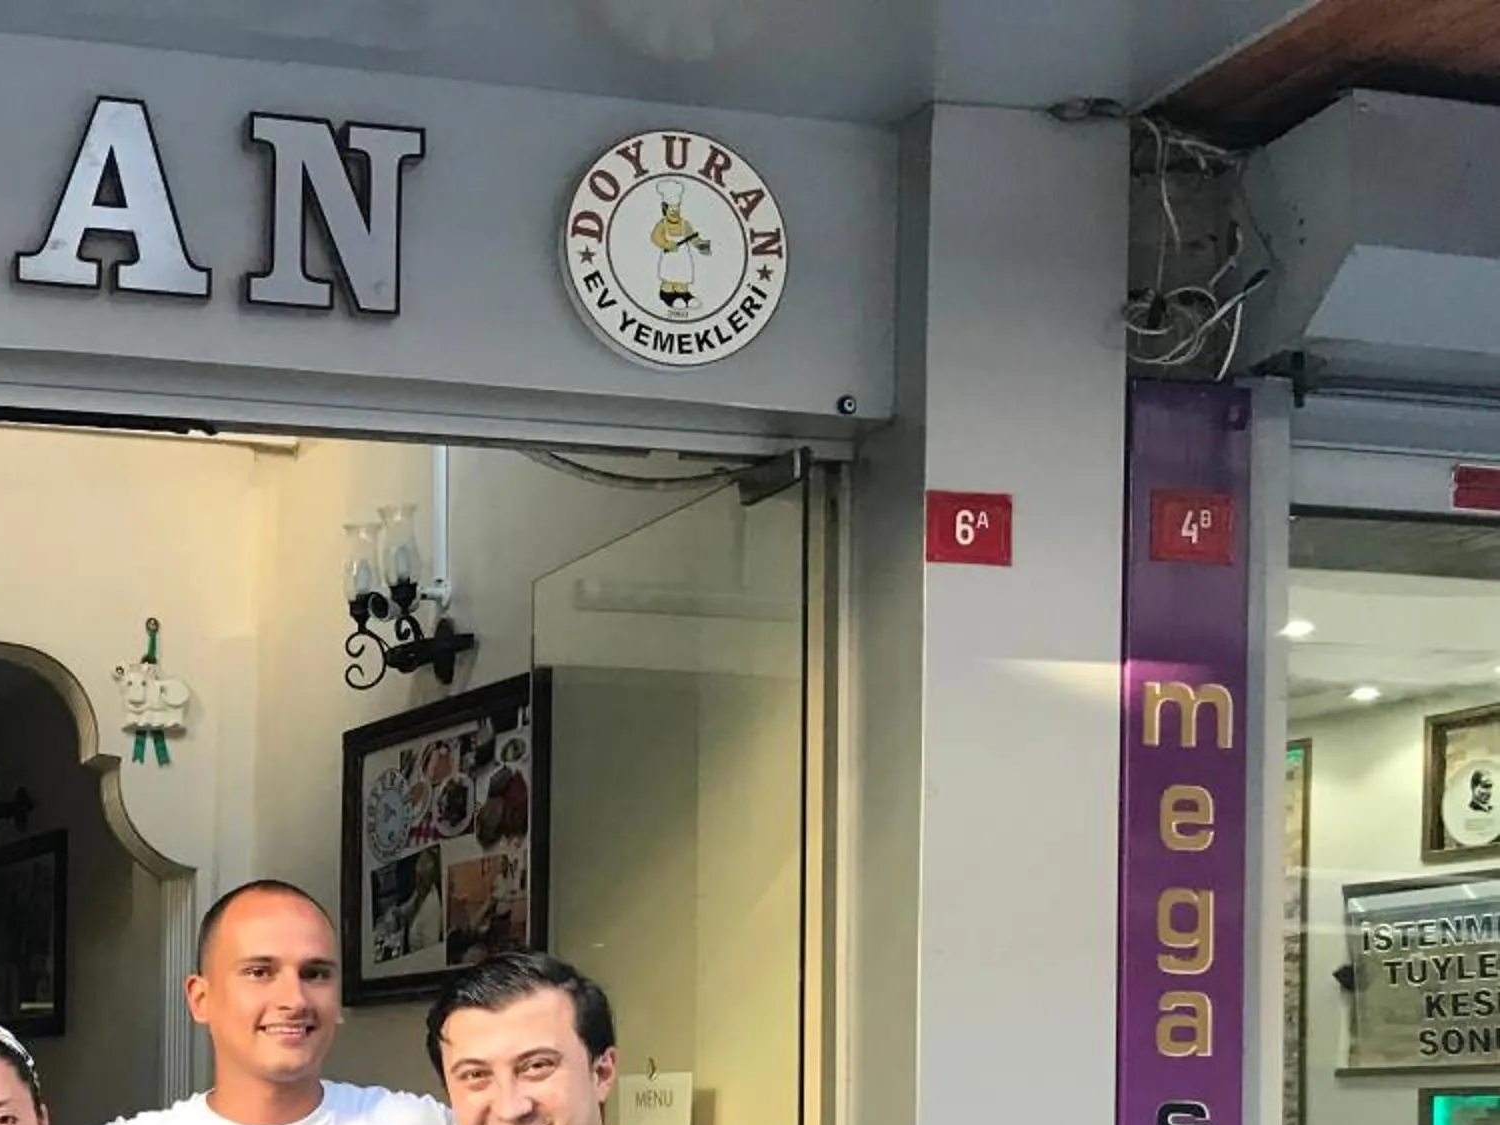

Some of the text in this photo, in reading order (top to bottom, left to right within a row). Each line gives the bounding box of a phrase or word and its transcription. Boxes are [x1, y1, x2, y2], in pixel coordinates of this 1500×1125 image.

[571, 135, 784, 260] DOYURAN
[583, 271, 769, 354] EV YEMEKLERİ
[1361, 912, 1500, 954] İSTENM
[1425, 988, 1500, 1020] KES
[1418, 1027, 1500, 1057] SON
[635, 1088, 673, 1108] MENU
